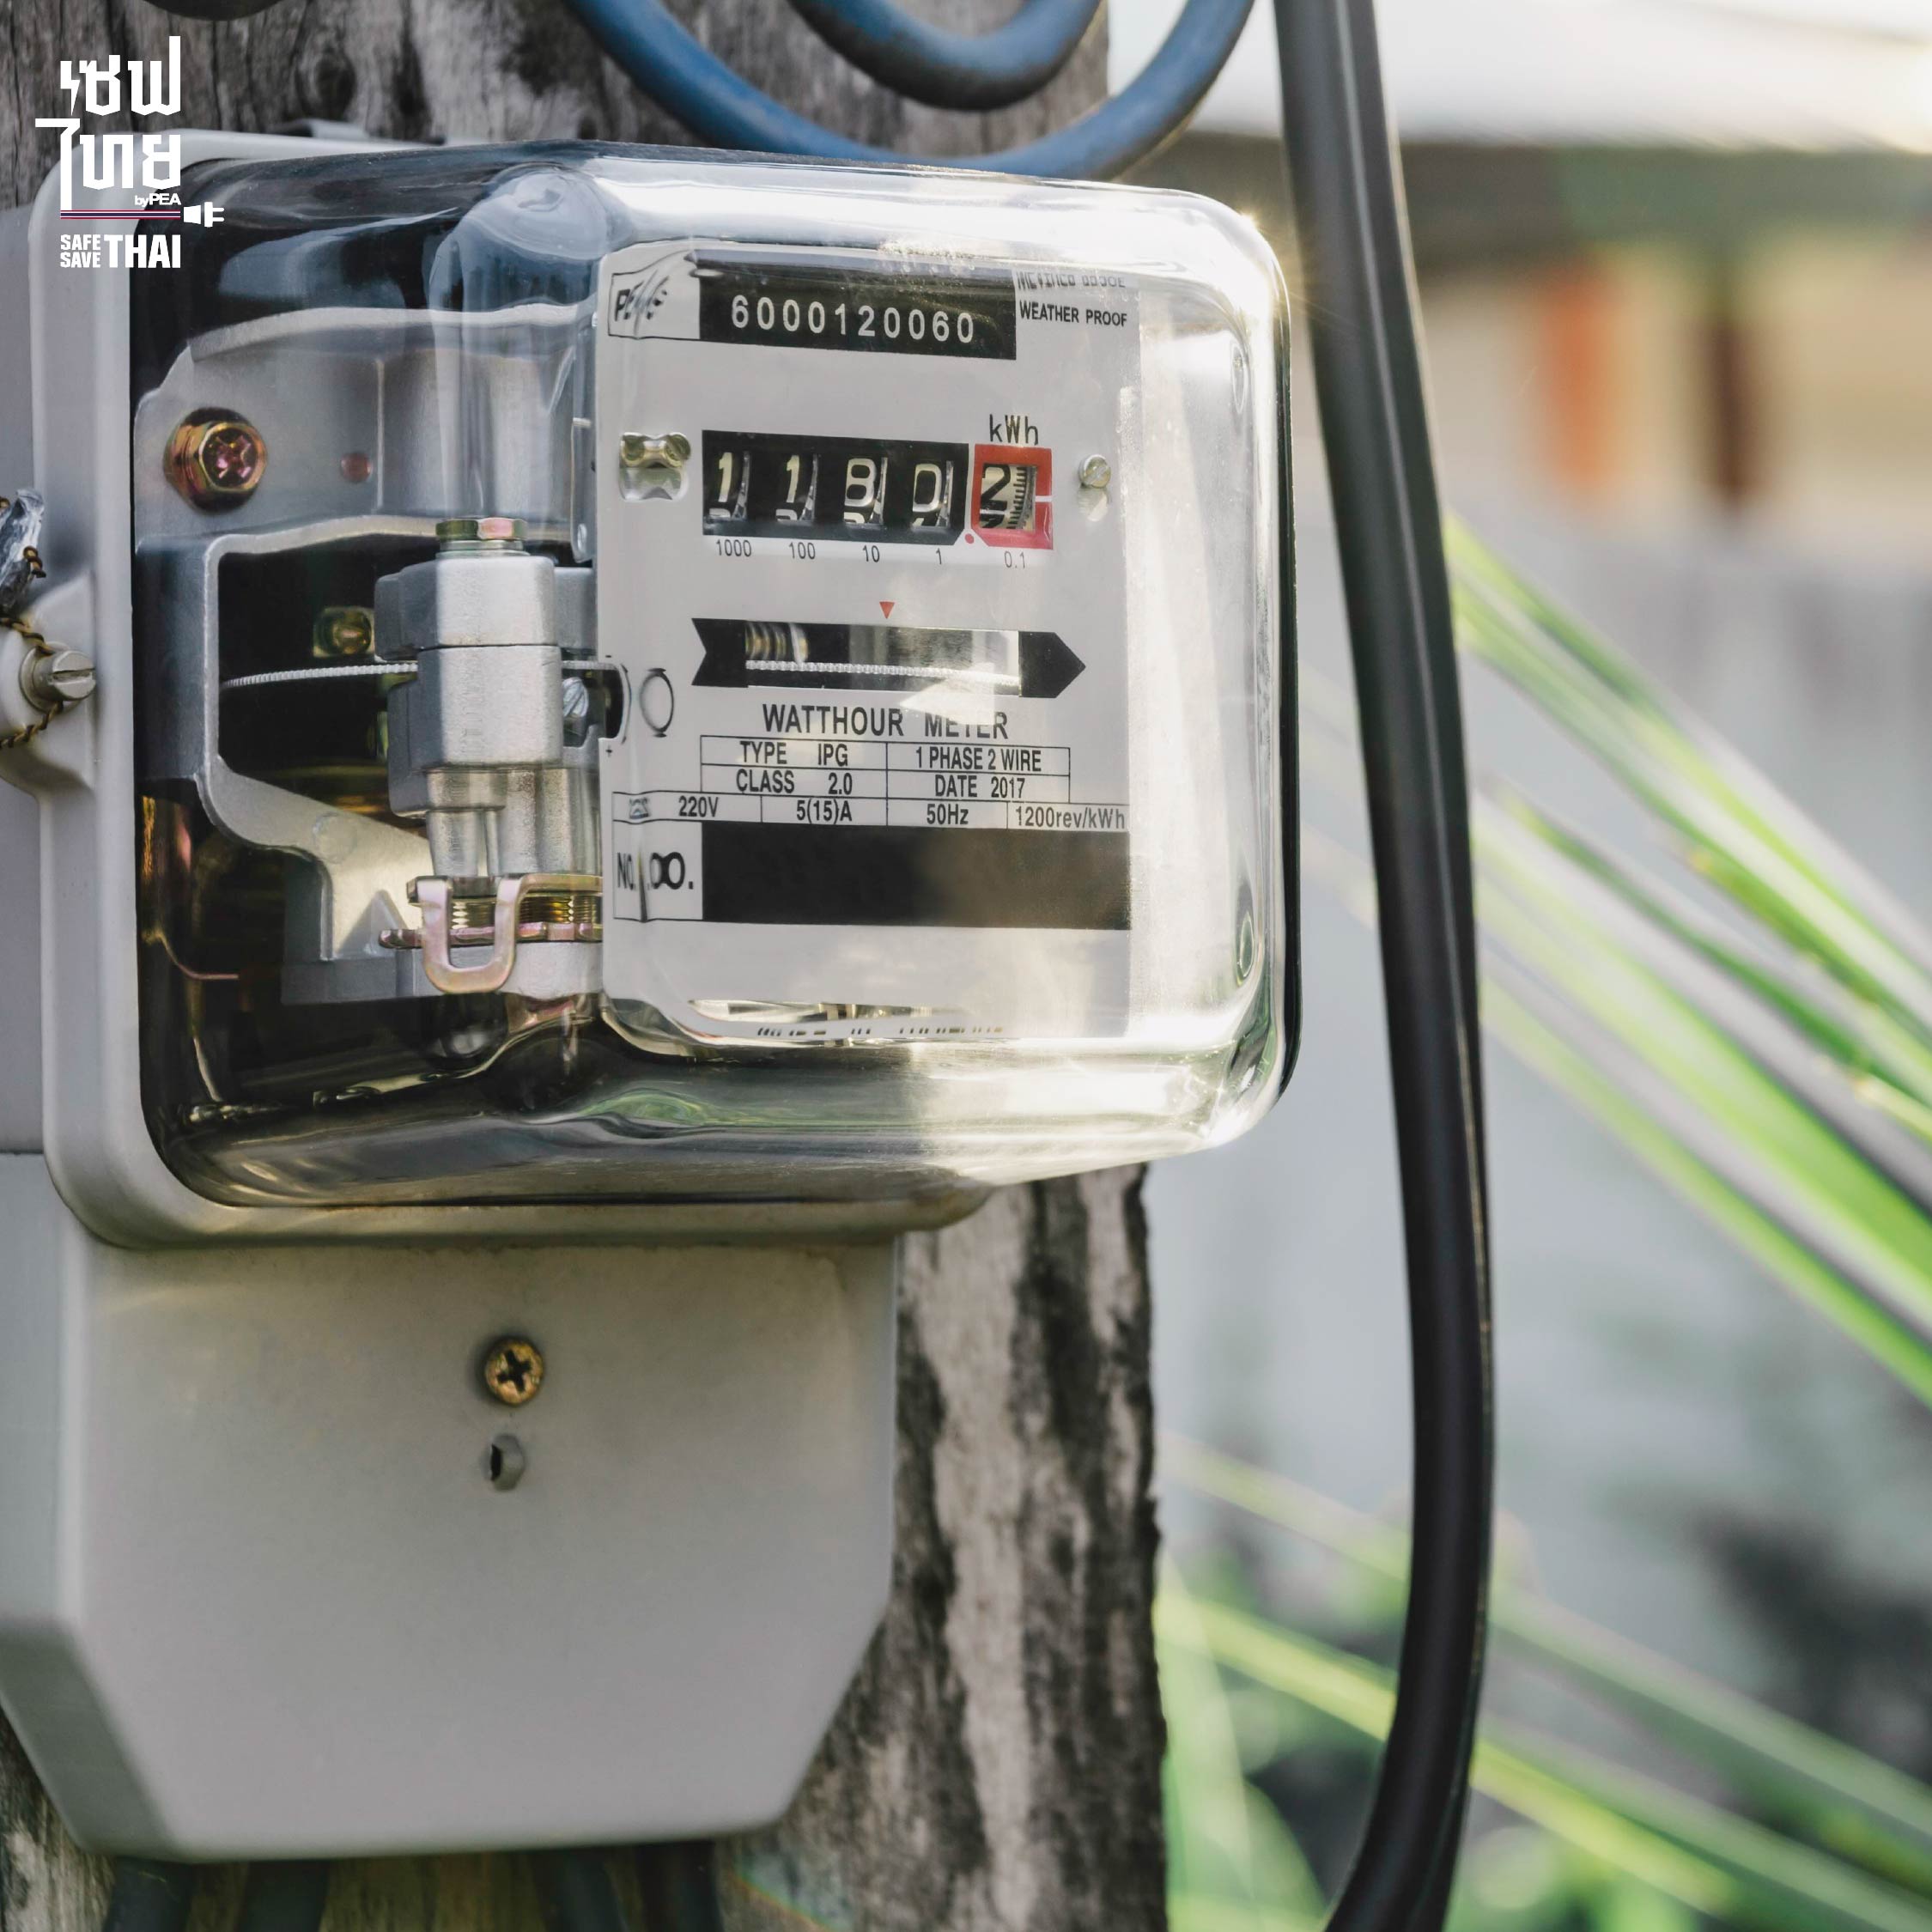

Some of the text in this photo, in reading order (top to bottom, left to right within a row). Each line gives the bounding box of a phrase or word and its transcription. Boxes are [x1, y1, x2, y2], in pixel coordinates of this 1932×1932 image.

[732, 295, 974, 343] 6000120060
[1019, 300, 1127, 326] WEATHER PROOF
[989, 414, 1039, 445] kWh
[716, 539, 1025, 568] 1000 100 10 1 0.1
[762, 703, 904, 737] WATTHOUR
[739, 740, 848, 767] TYPE IPG
[915, 746, 1042, 772] 1 PHASE 2 WIRE
[736, 769, 853, 795] CLASS 2.0
[934, 775, 1025, 799] DATE 2017
[677, 795, 719, 817] 220V
[796, 798, 853, 824] 5(15)A
[926, 804, 969, 825] 50Hz
[1014, 805, 1125, 829] 1200rev/kWh
